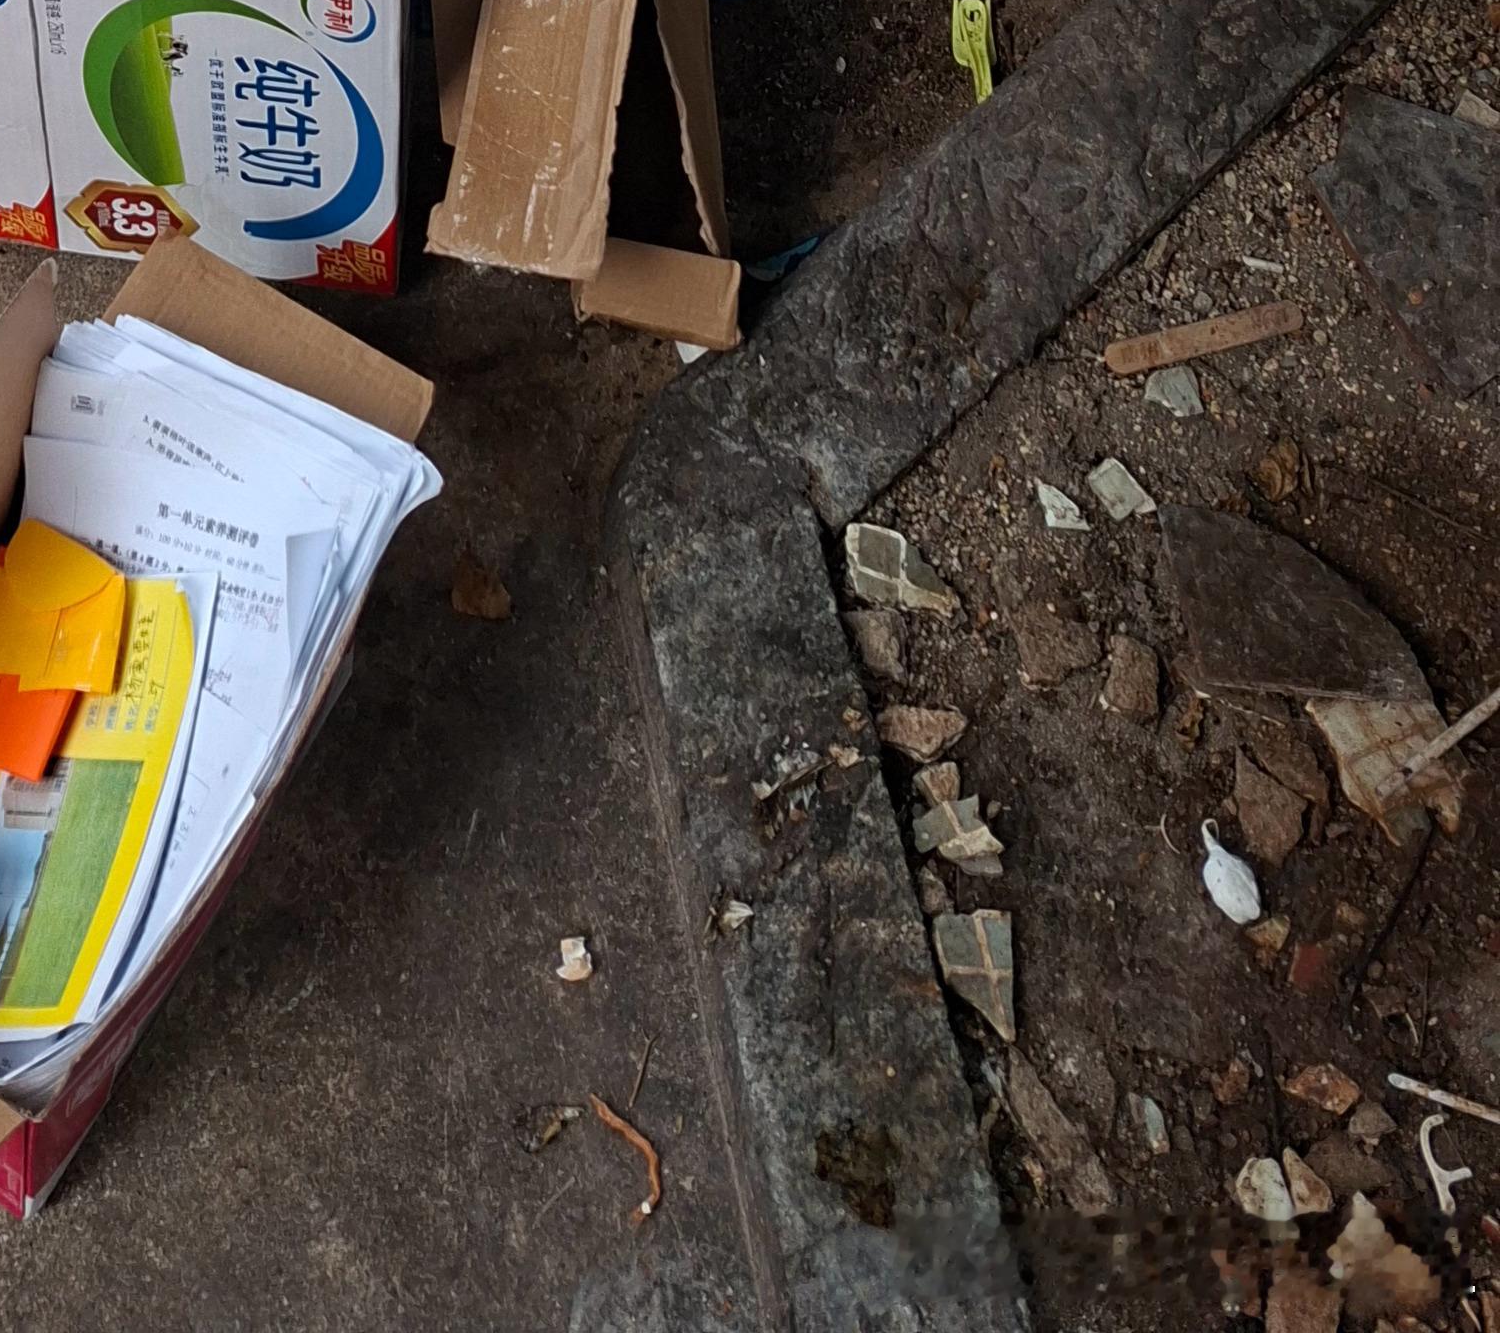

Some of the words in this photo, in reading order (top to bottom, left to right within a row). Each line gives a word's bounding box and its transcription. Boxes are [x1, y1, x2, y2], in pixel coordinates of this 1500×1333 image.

[234, 56, 321, 189] 纯牛奶
[111, 198, 156, 236] 3.3
[157, 501, 260, 548] 第一单元素养测评卷
